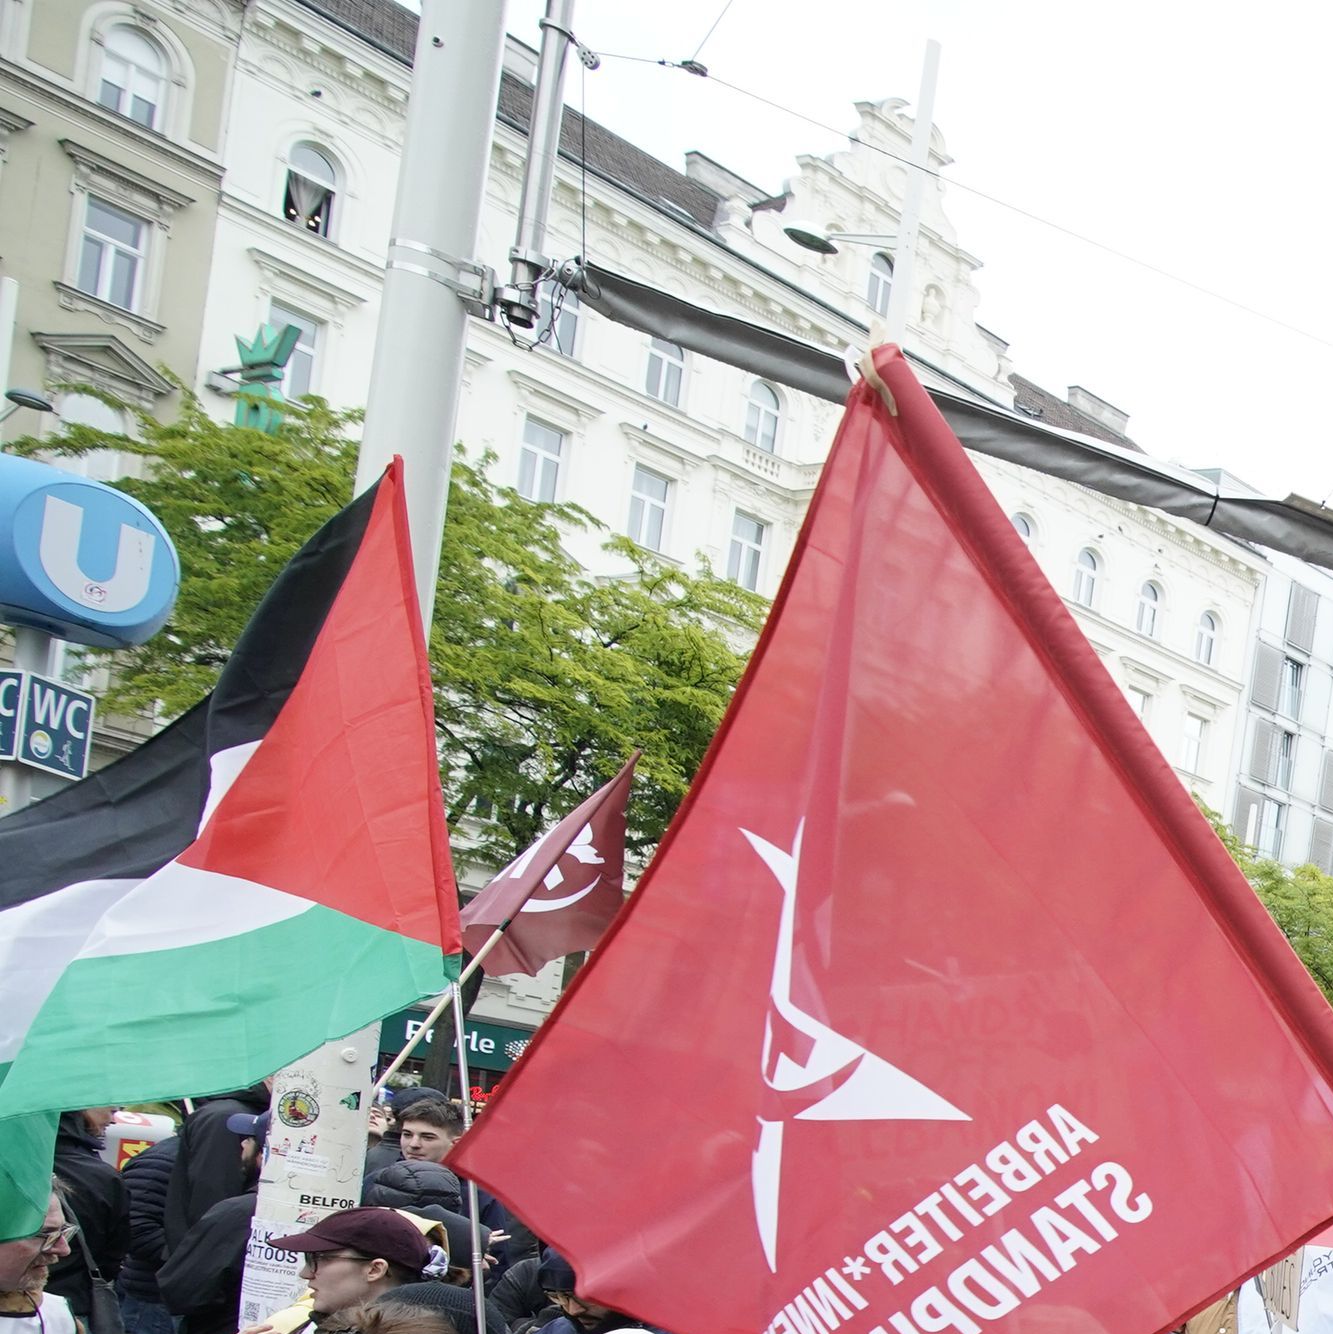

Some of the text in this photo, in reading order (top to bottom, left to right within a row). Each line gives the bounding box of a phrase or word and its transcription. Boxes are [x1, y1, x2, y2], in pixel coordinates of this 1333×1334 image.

[39, 494, 156, 613] U
[32, 683, 89, 739] WC
[405, 1019, 495, 1054] Perle
